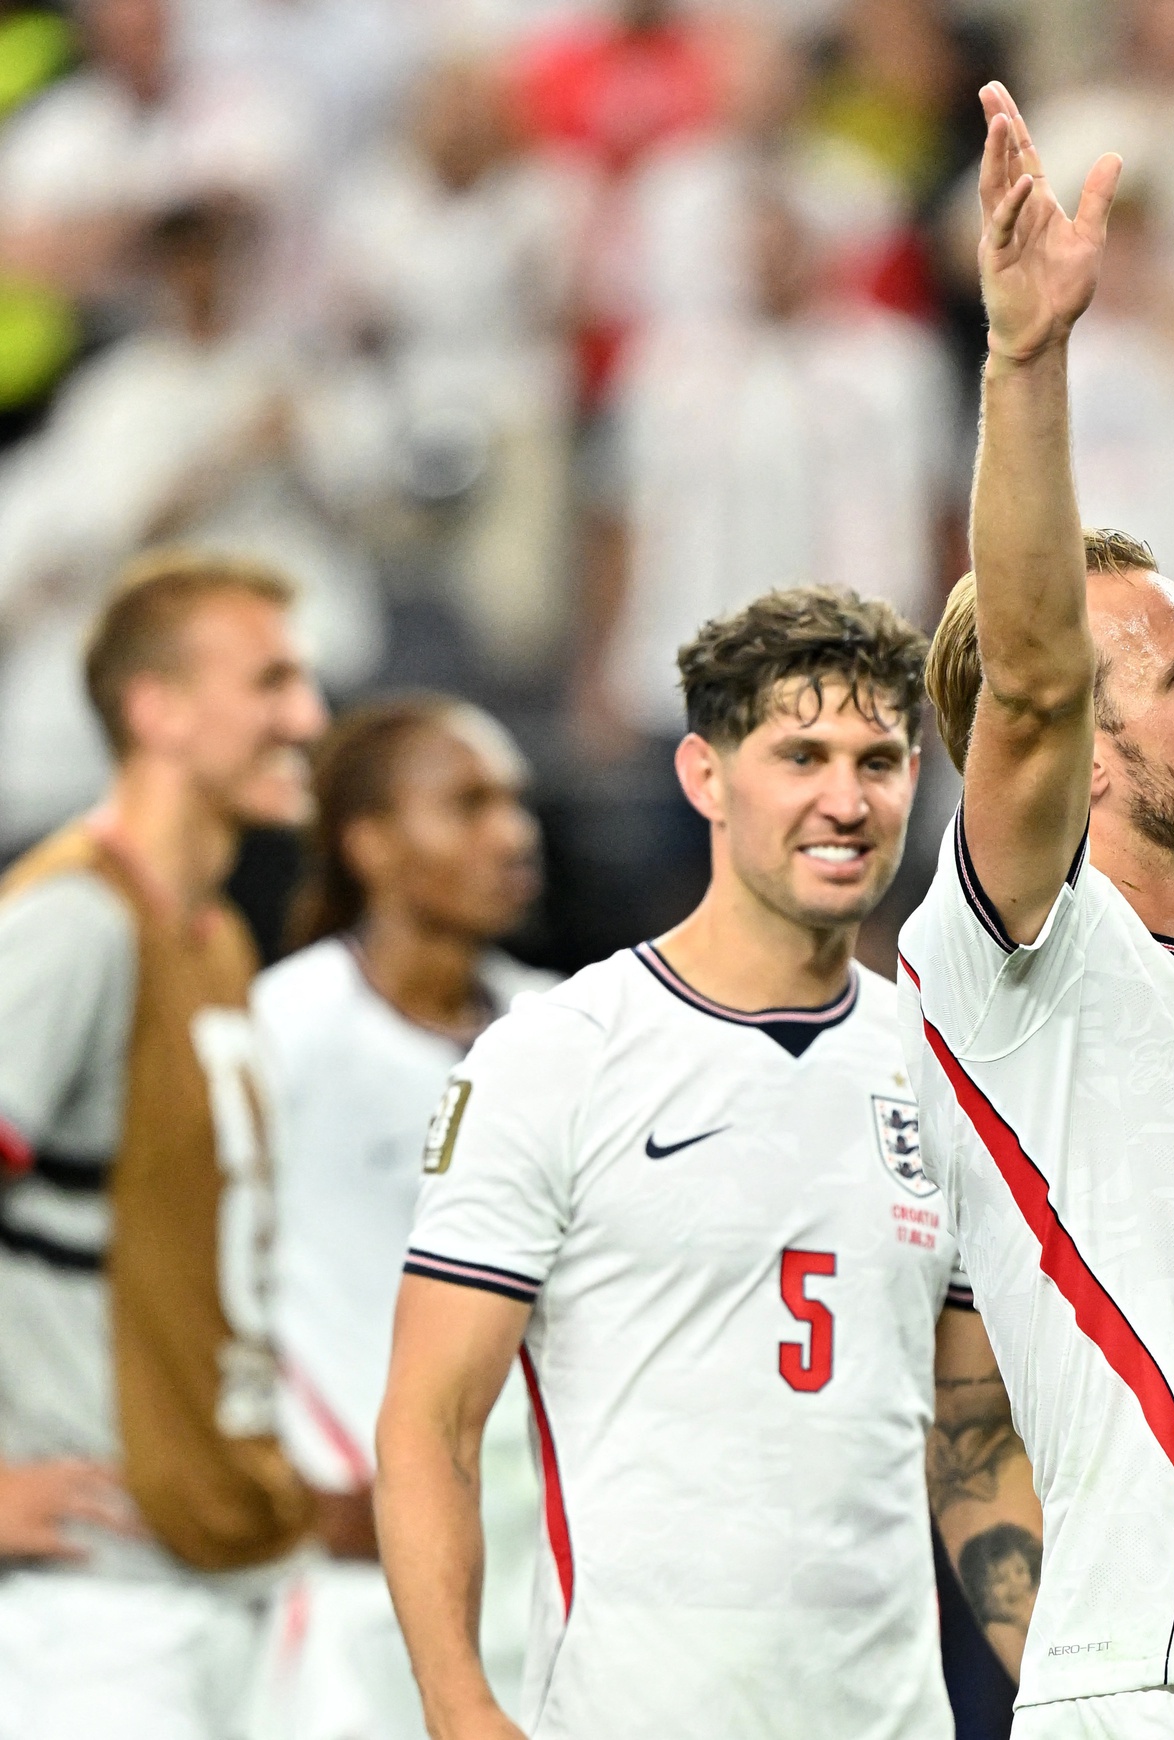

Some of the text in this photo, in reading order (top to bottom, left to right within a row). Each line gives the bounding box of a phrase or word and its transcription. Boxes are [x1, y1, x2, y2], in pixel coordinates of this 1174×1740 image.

[892, 1205, 939, 1228] CROATIA
[779, 1249, 836, 1393] 5
[1048, 1641, 1112, 1656] AERO-FIT
